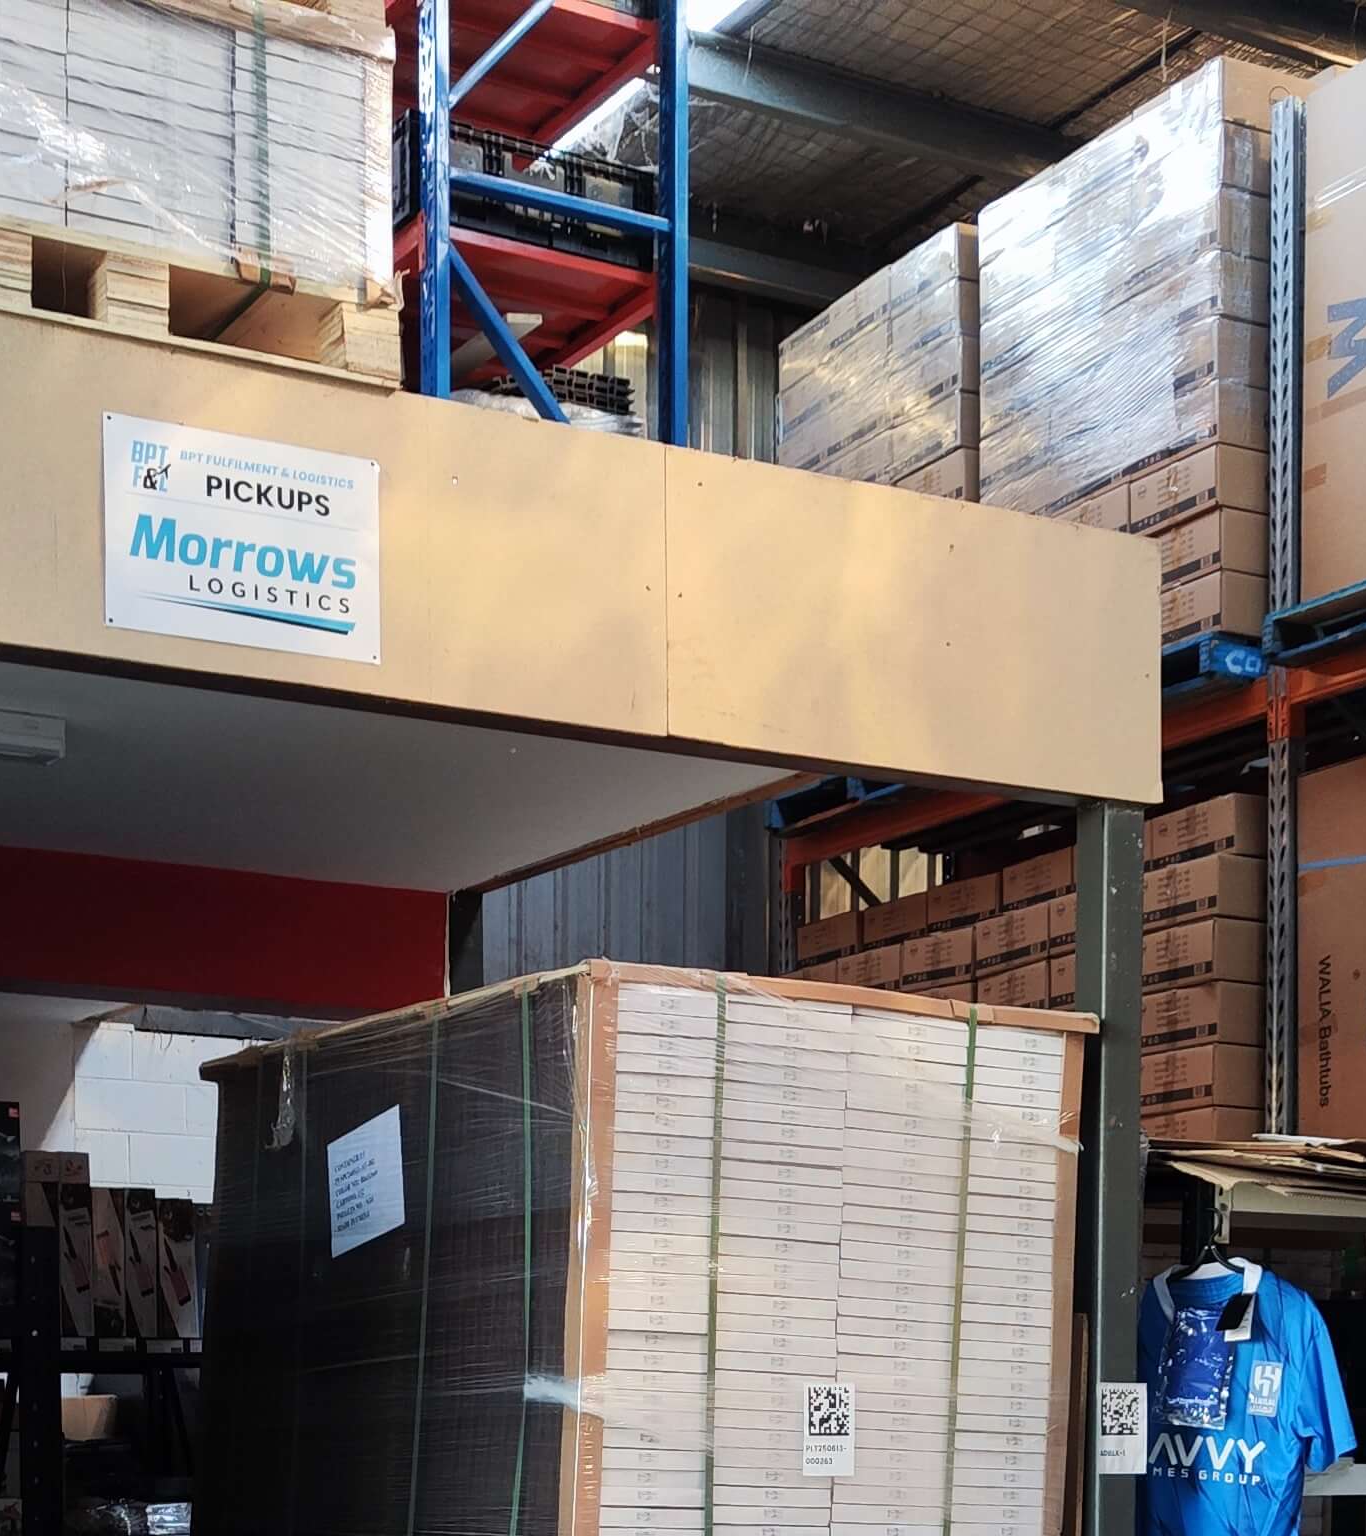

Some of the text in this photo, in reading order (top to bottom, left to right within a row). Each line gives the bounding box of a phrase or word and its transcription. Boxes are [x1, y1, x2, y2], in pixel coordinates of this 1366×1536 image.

[131, 440, 169, 466] BPT
[179, 450, 354, 490] BPT FULFILMENT & LOGISTICS
[206, 475, 330, 516] PICKUPS
[129, 513, 357, 590] Morrows
[189, 574, 350, 614] LOGISTICS
[1319, 954, 1332, 1107] WALIA Bathtubs
[1148, 1432, 1265, 1474] AVVY
[1152, 1467, 1261, 1486] MES GROUP
